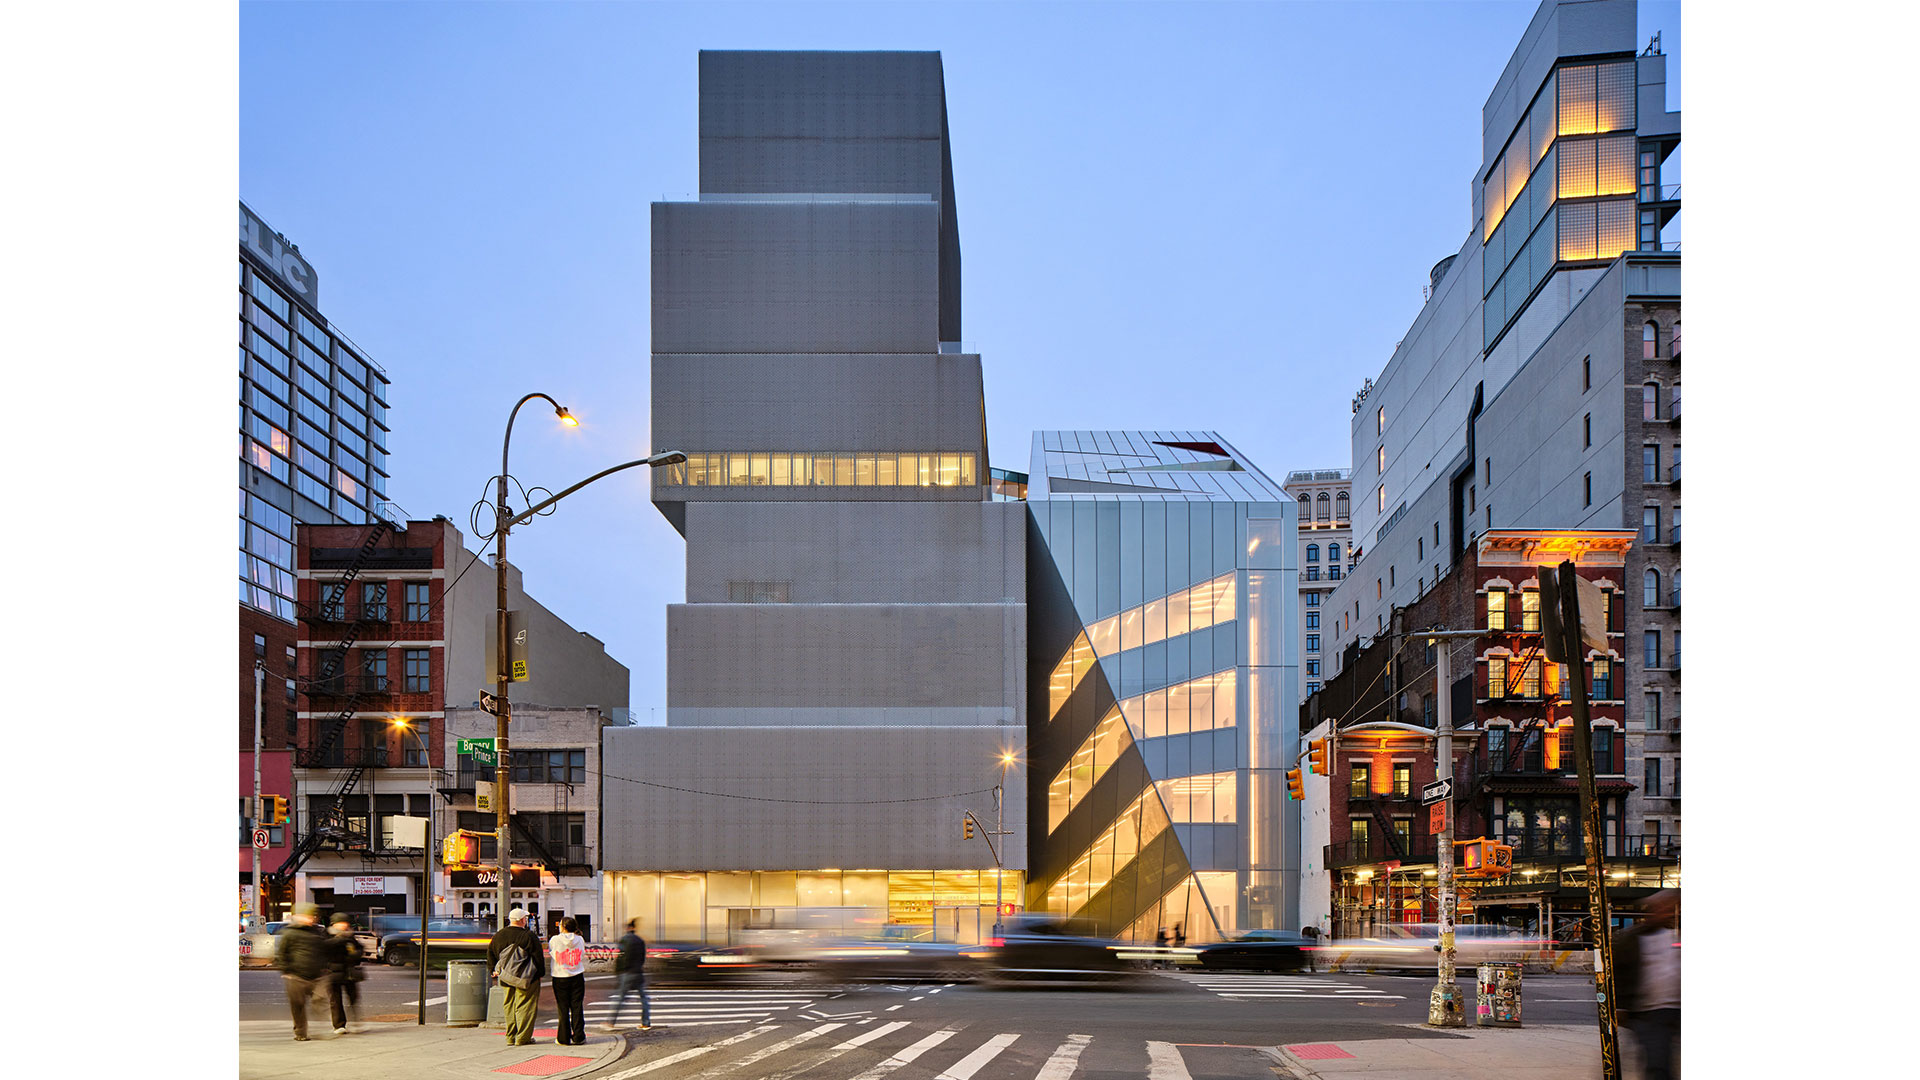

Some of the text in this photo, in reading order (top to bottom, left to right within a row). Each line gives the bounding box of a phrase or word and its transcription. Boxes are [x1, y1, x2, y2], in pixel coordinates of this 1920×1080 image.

[475, 747, 491, 763] Prince
[1436, 784, 1447, 795] WAY
[1432, 804, 1444, 817] RAISE
[1432, 819, 1443, 831] PLOW
